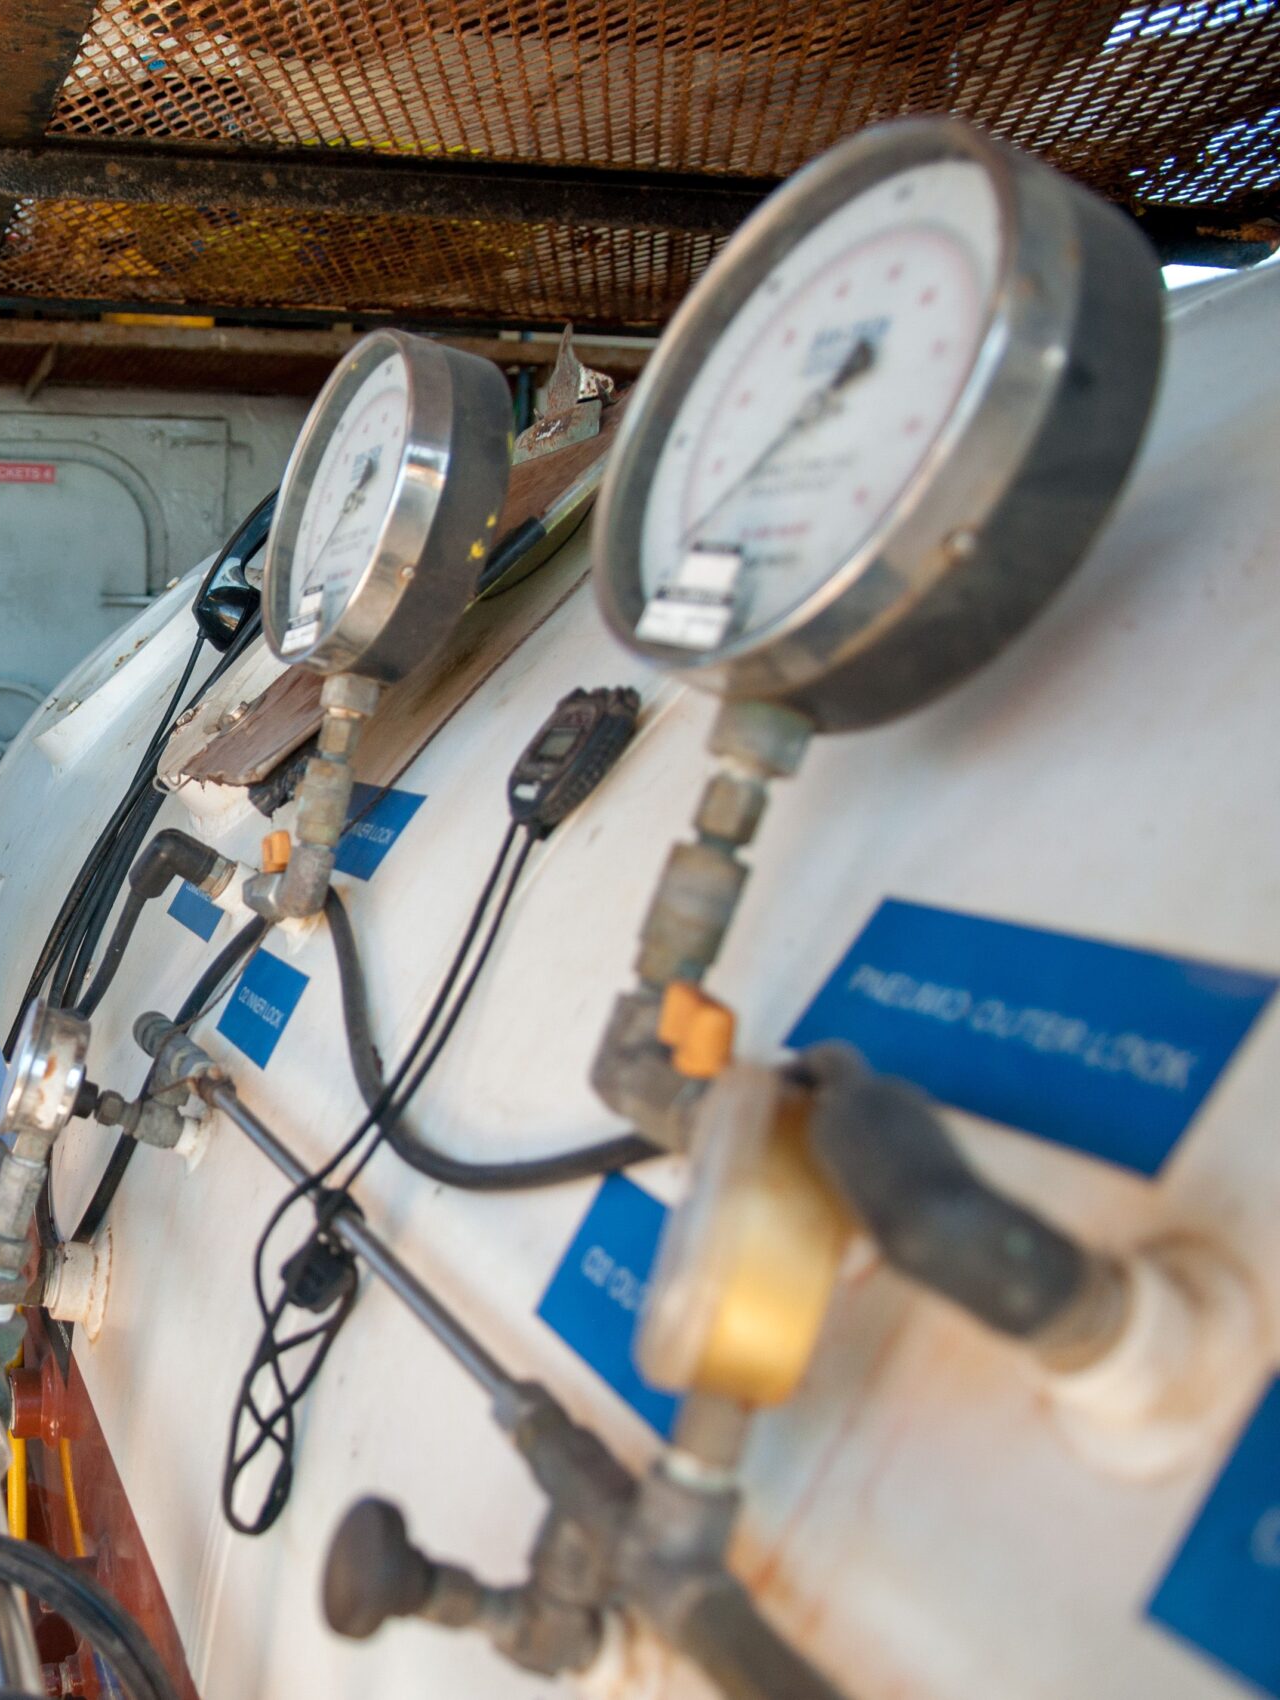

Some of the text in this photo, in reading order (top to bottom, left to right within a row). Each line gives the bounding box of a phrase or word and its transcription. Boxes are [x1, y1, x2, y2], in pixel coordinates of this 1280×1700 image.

[368, 826, 395, 844] LOCK
[262, 1004, 284, 1029] LOCK
[848, 964, 1199, 1092] PNEUMO OUTER LOCK
